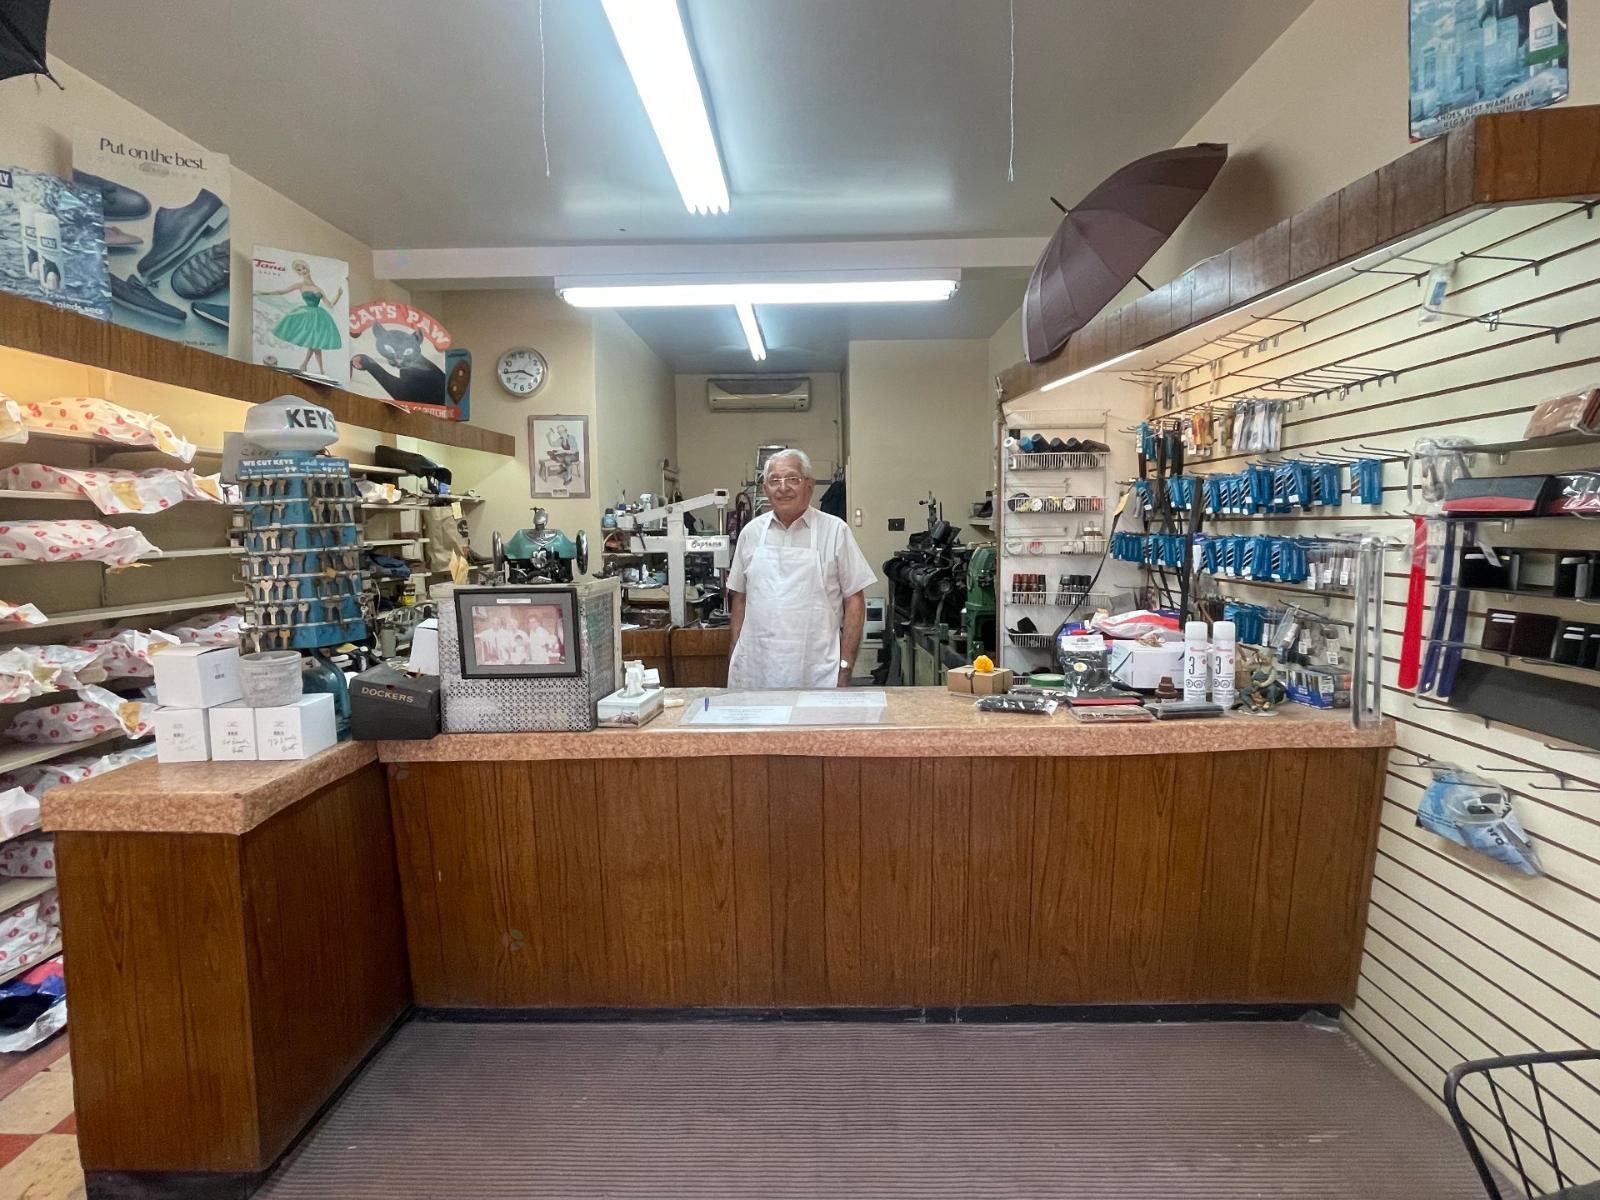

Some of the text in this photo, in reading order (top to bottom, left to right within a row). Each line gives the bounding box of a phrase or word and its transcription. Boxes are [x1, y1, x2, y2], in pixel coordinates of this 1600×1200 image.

[1464, 104, 1483, 116] JUST
[1485, 96, 1511, 109] WANT
[99, 137, 126, 155] Put
[128, 147, 148, 161] on
[150, 148, 173, 165] the
[253, 258, 286, 272] Tana
[349, 302, 451, 344] CAT'S PAW
[285, 408, 336, 433] KEYS
[1189, 656, 1195, 675] 3
[1215, 655, 1222, 675] 3
[361, 686, 414, 703] DOCKERS
